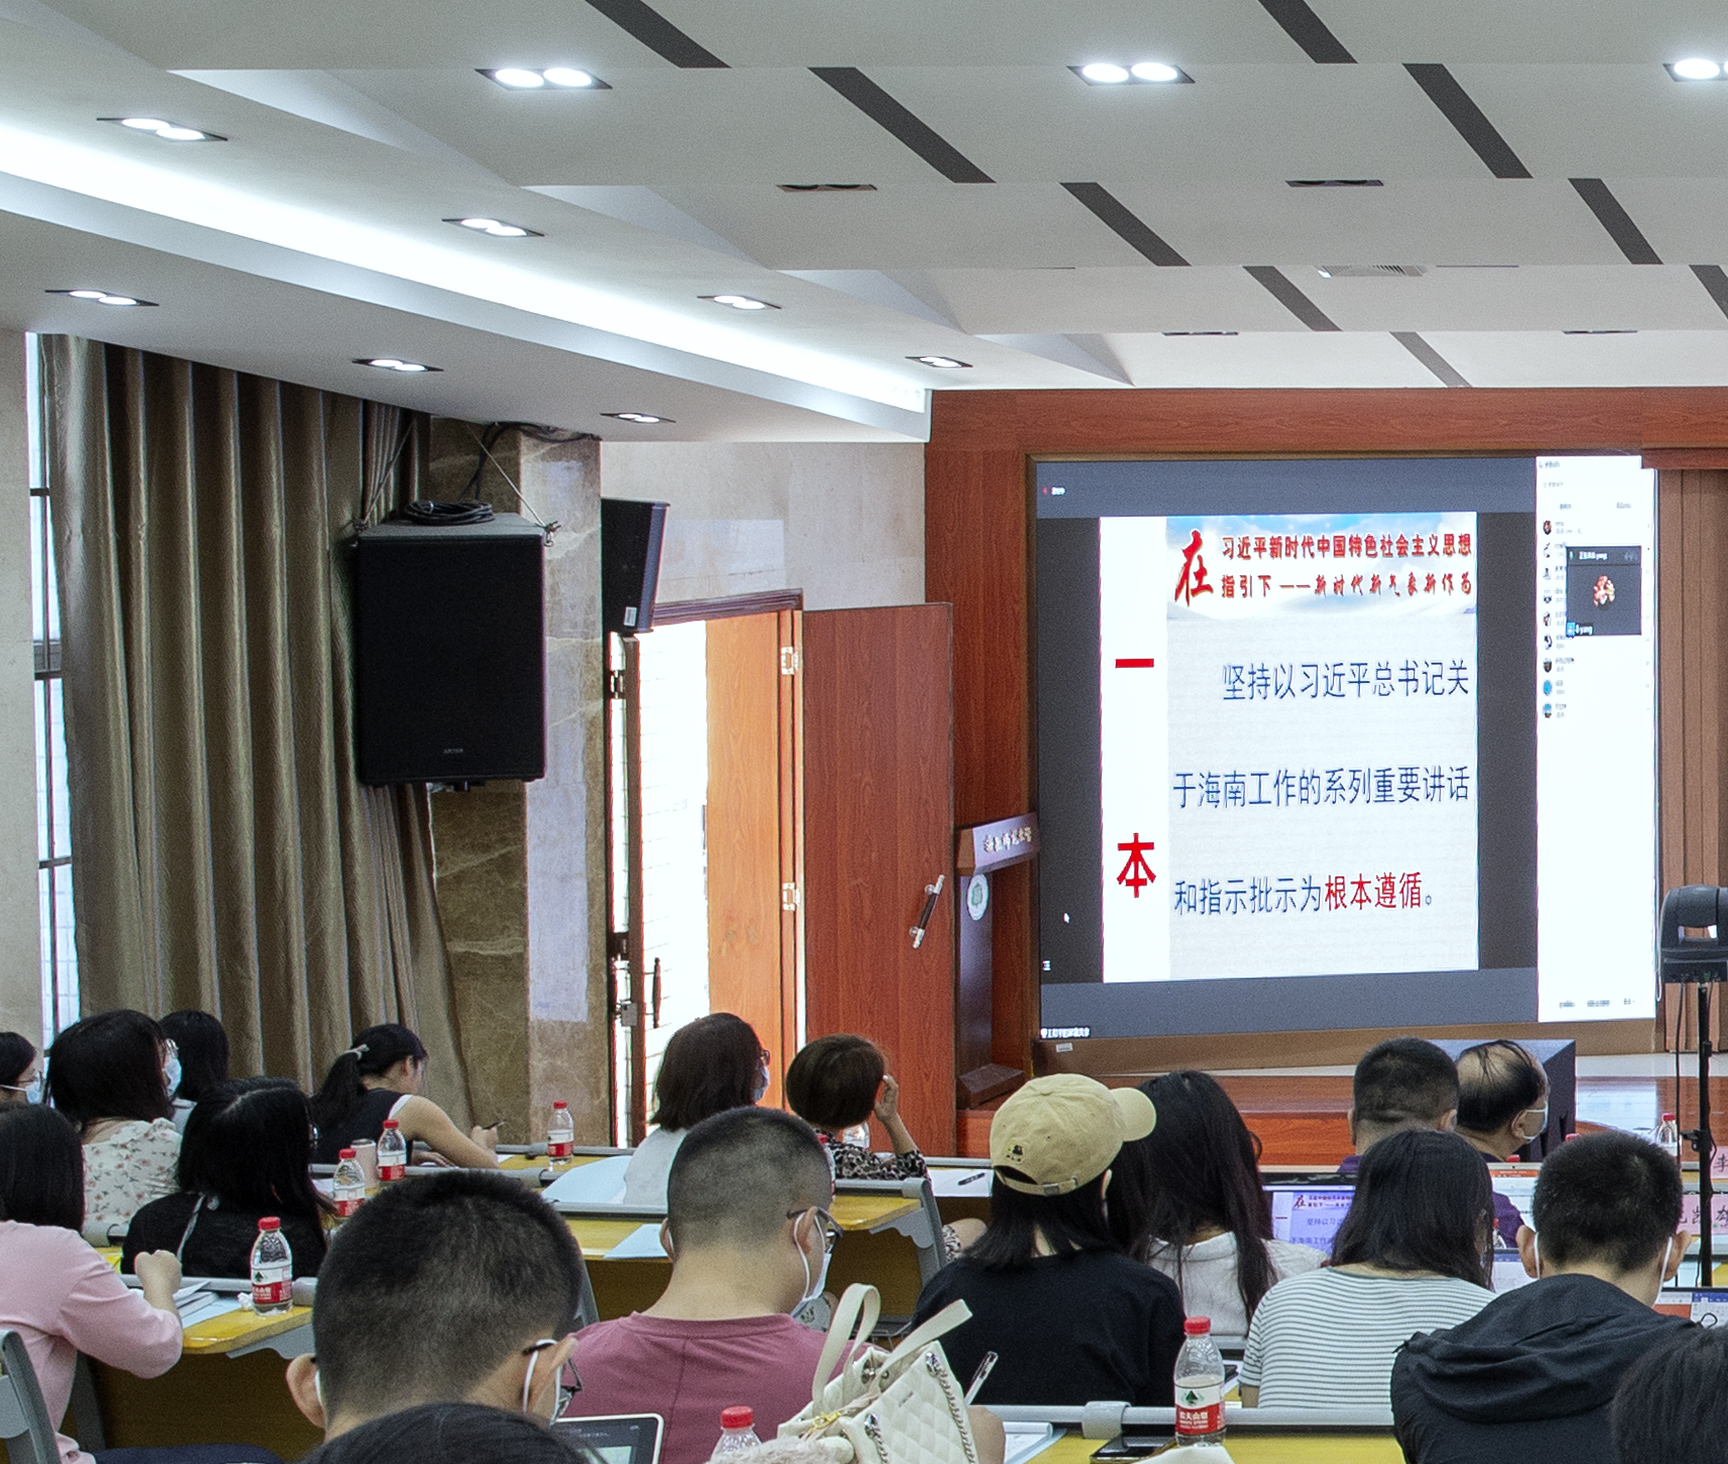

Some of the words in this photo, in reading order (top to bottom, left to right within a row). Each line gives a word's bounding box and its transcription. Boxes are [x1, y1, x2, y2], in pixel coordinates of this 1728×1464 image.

[1175, 530, 1215, 607] 在
[1221, 532, 1473, 561] 习近平新时代中国特色社会主义思想
[1222, 659, 1471, 701] 坚持以习近平总书记关
[1172, 766, 1471, 809] 于海南工作的系列重要讲话
[1116, 832, 1157, 898] 本
[1174, 871, 1433, 917] 和指示批示为根本遵循。
